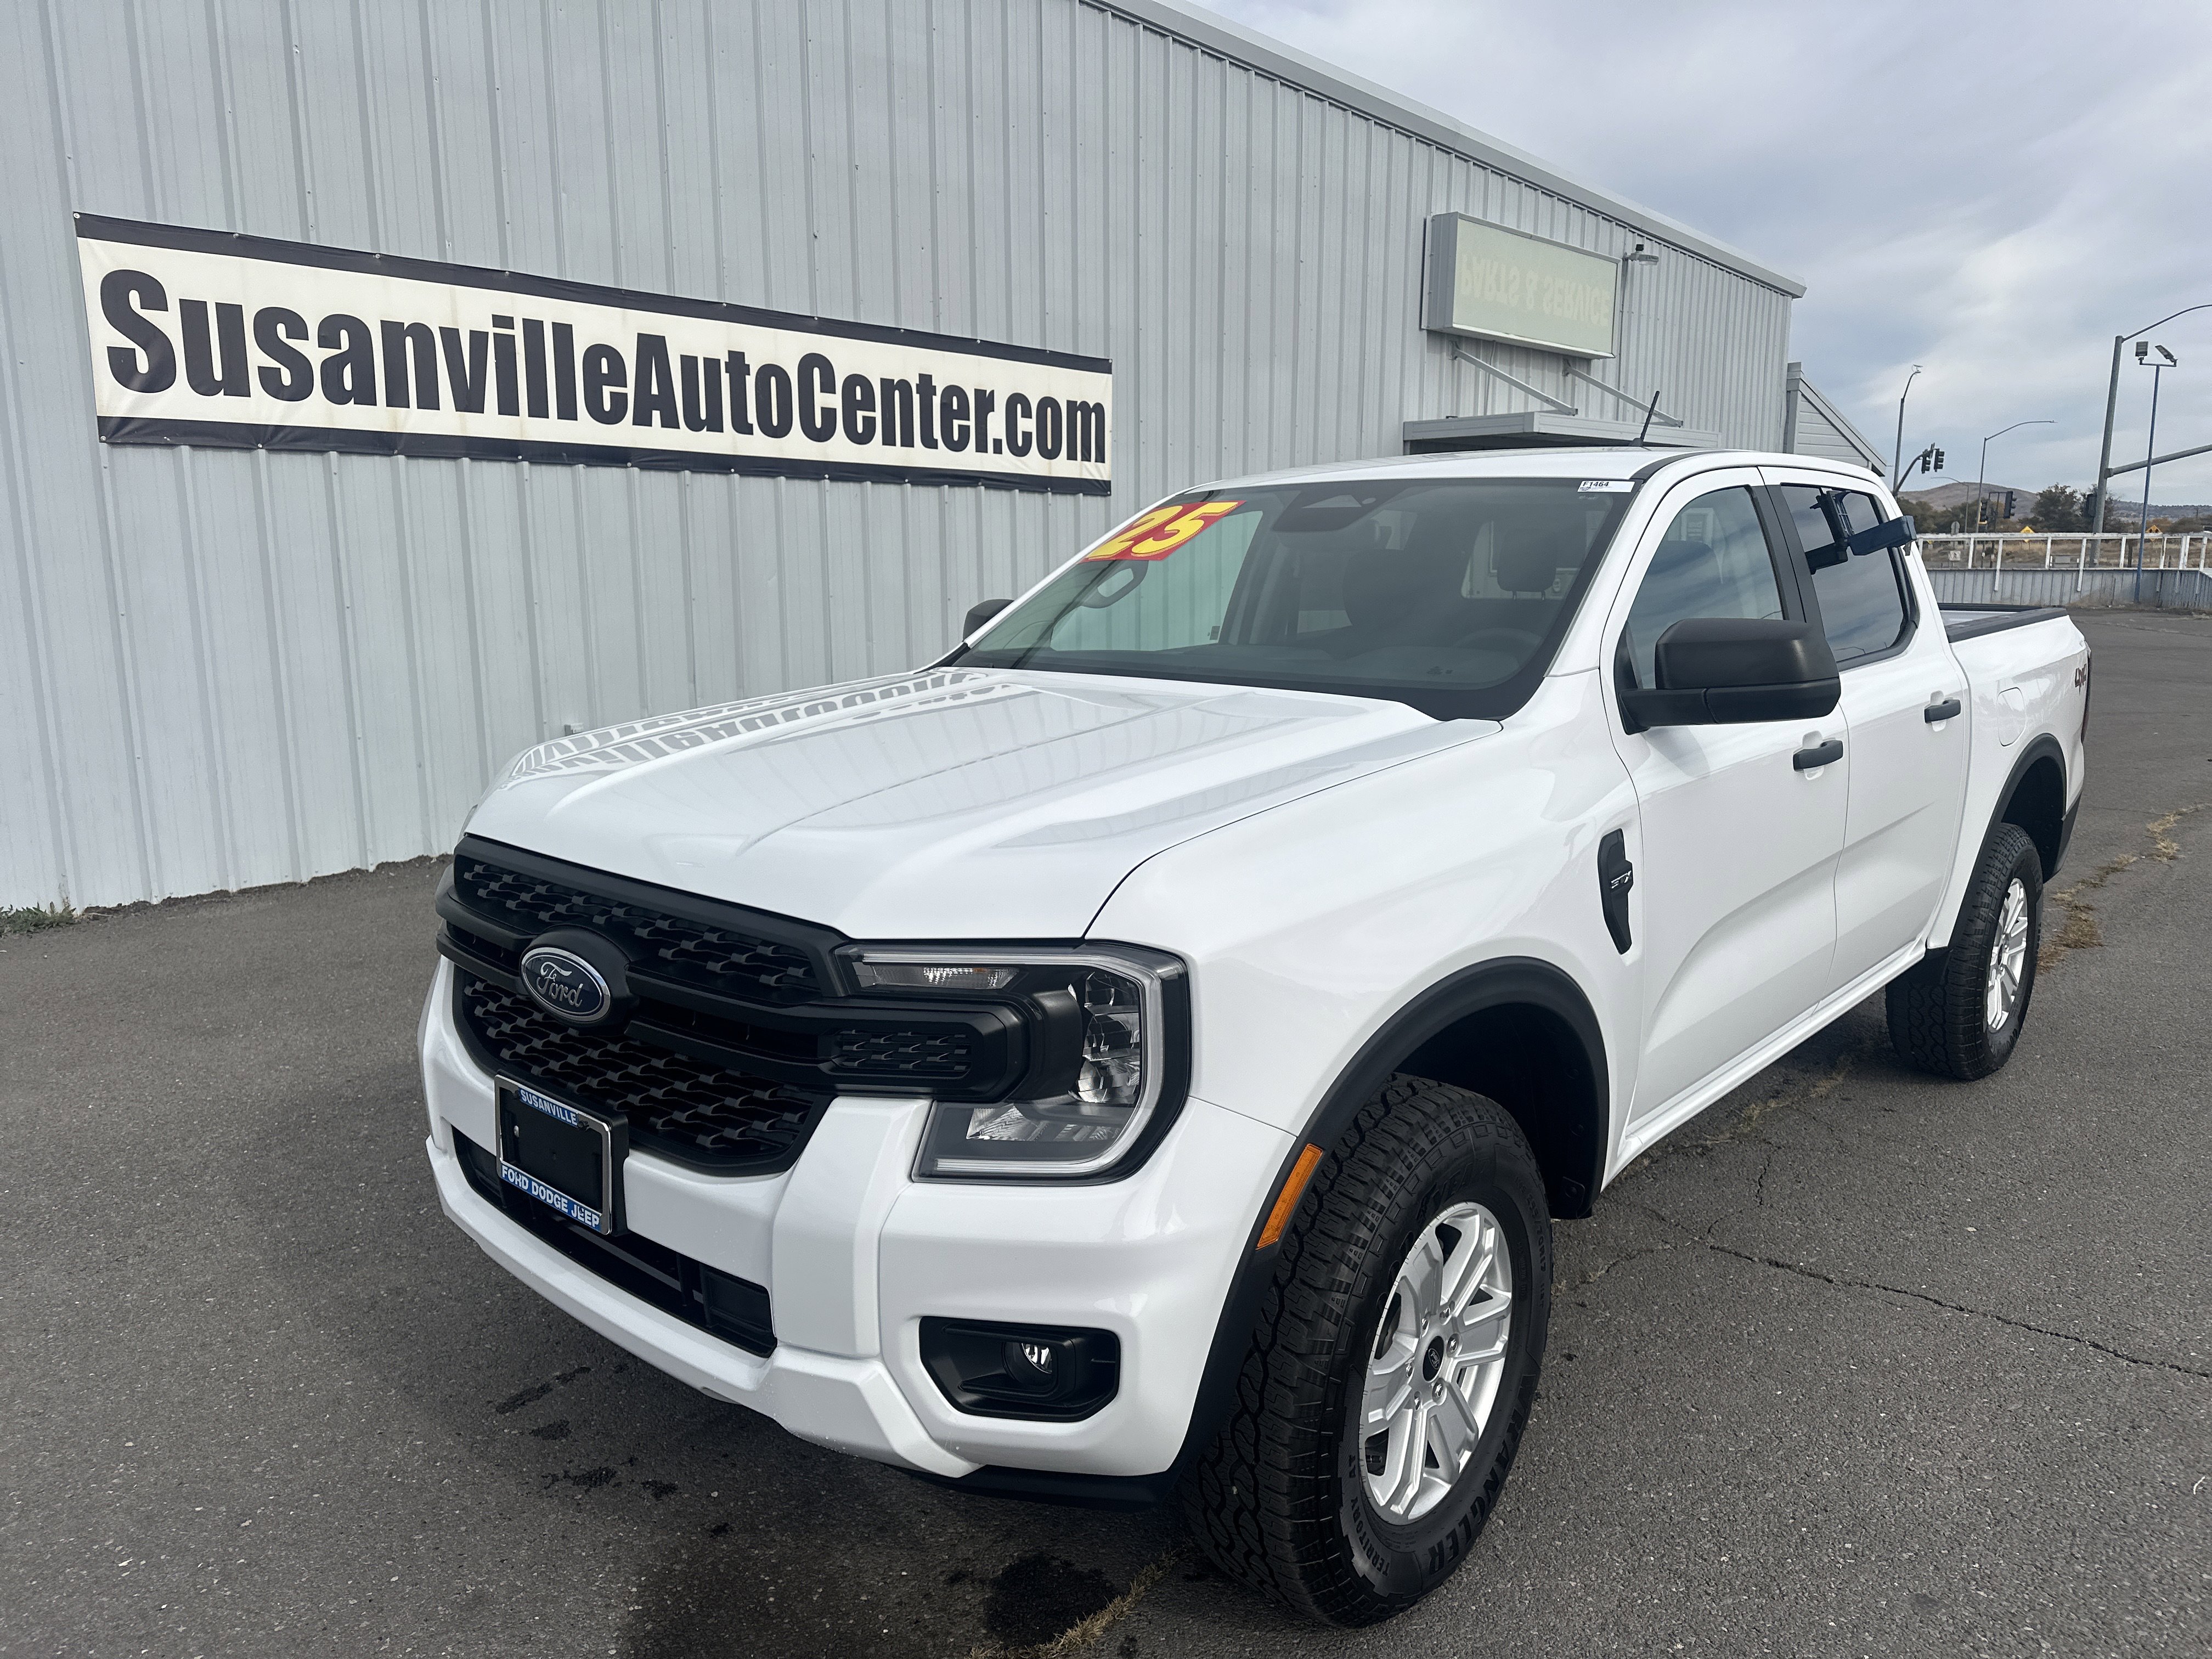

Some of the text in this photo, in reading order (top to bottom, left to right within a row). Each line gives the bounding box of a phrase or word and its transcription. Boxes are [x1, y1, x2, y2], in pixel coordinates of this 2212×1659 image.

[100, 268, 1105, 464] SusanvilleAutoCenter.com
[1083, 501, 1239, 560] 25
[536, 961, 584, 1007] Ford
[520, 1089, 578, 1126] SUSANVILLE
[501, 1165, 600, 1228] FORD DODGE JEEP
[1427, 1374, 1537, 1576] WRANGLER
[1350, 1496, 1391, 1577] TERRITORY
